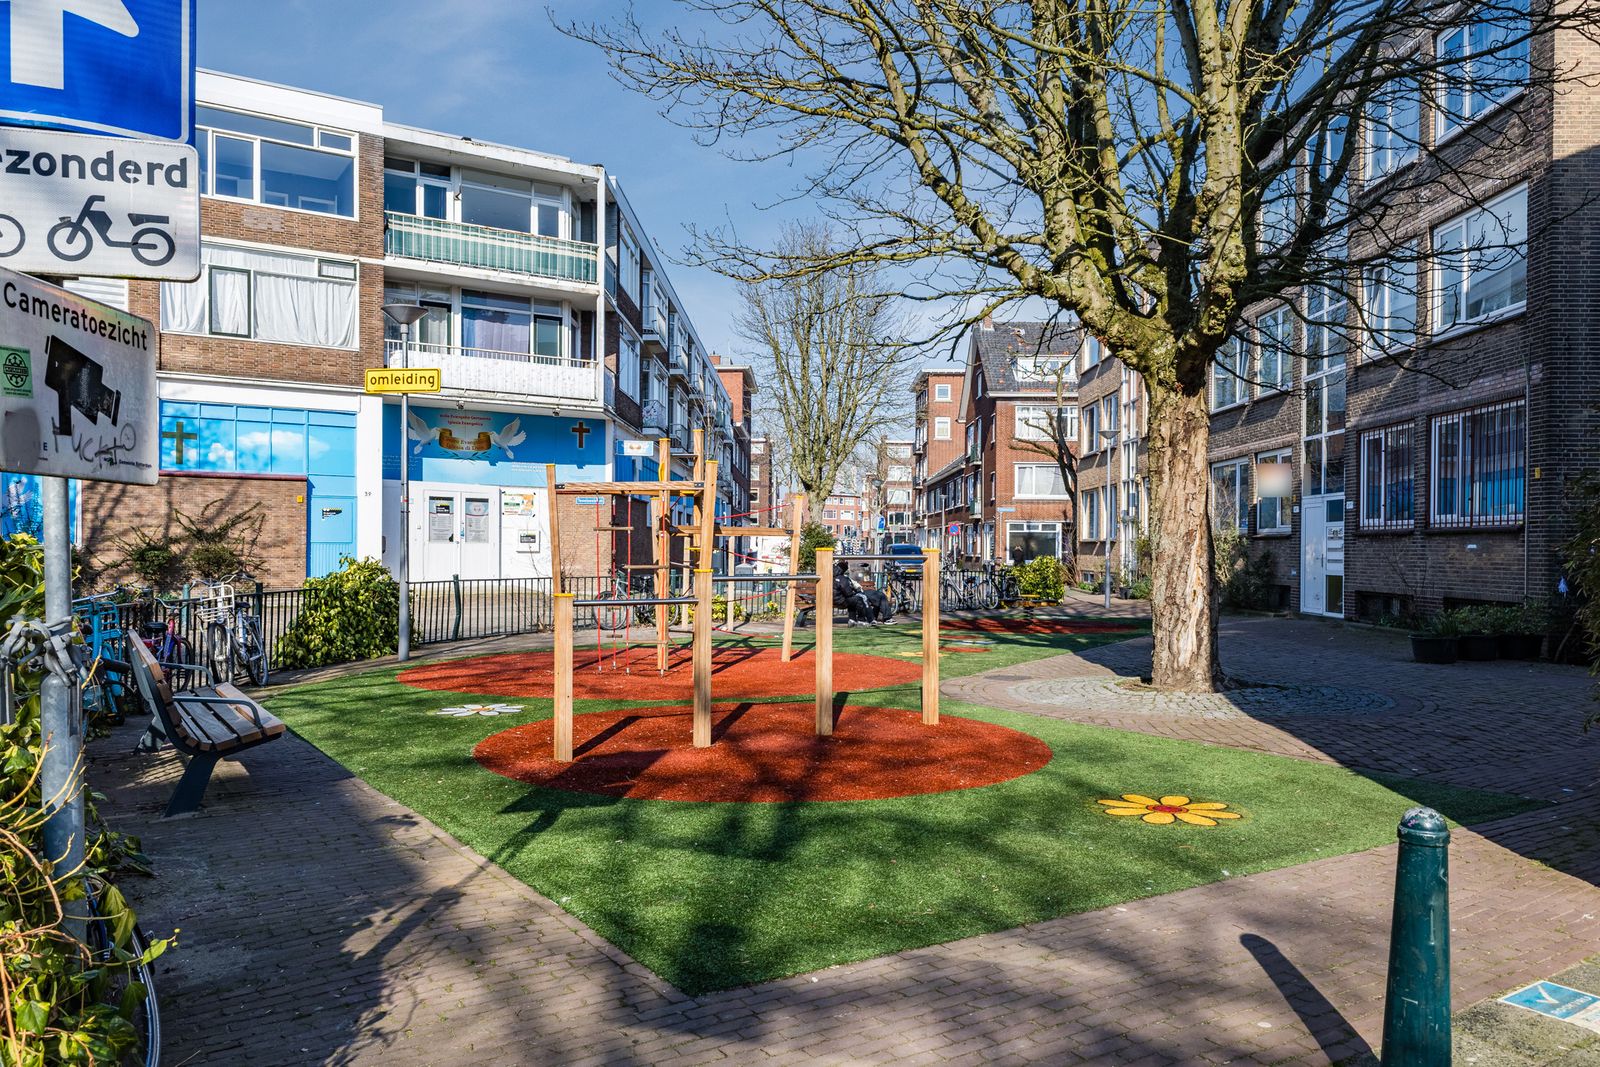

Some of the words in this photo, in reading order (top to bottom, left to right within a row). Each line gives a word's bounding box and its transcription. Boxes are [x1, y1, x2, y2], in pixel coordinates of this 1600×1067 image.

[0, 149, 188, 188] zonderd
[4, 281, 148, 351] Cameratoezicht
[370, 373, 435, 388] omleiding
